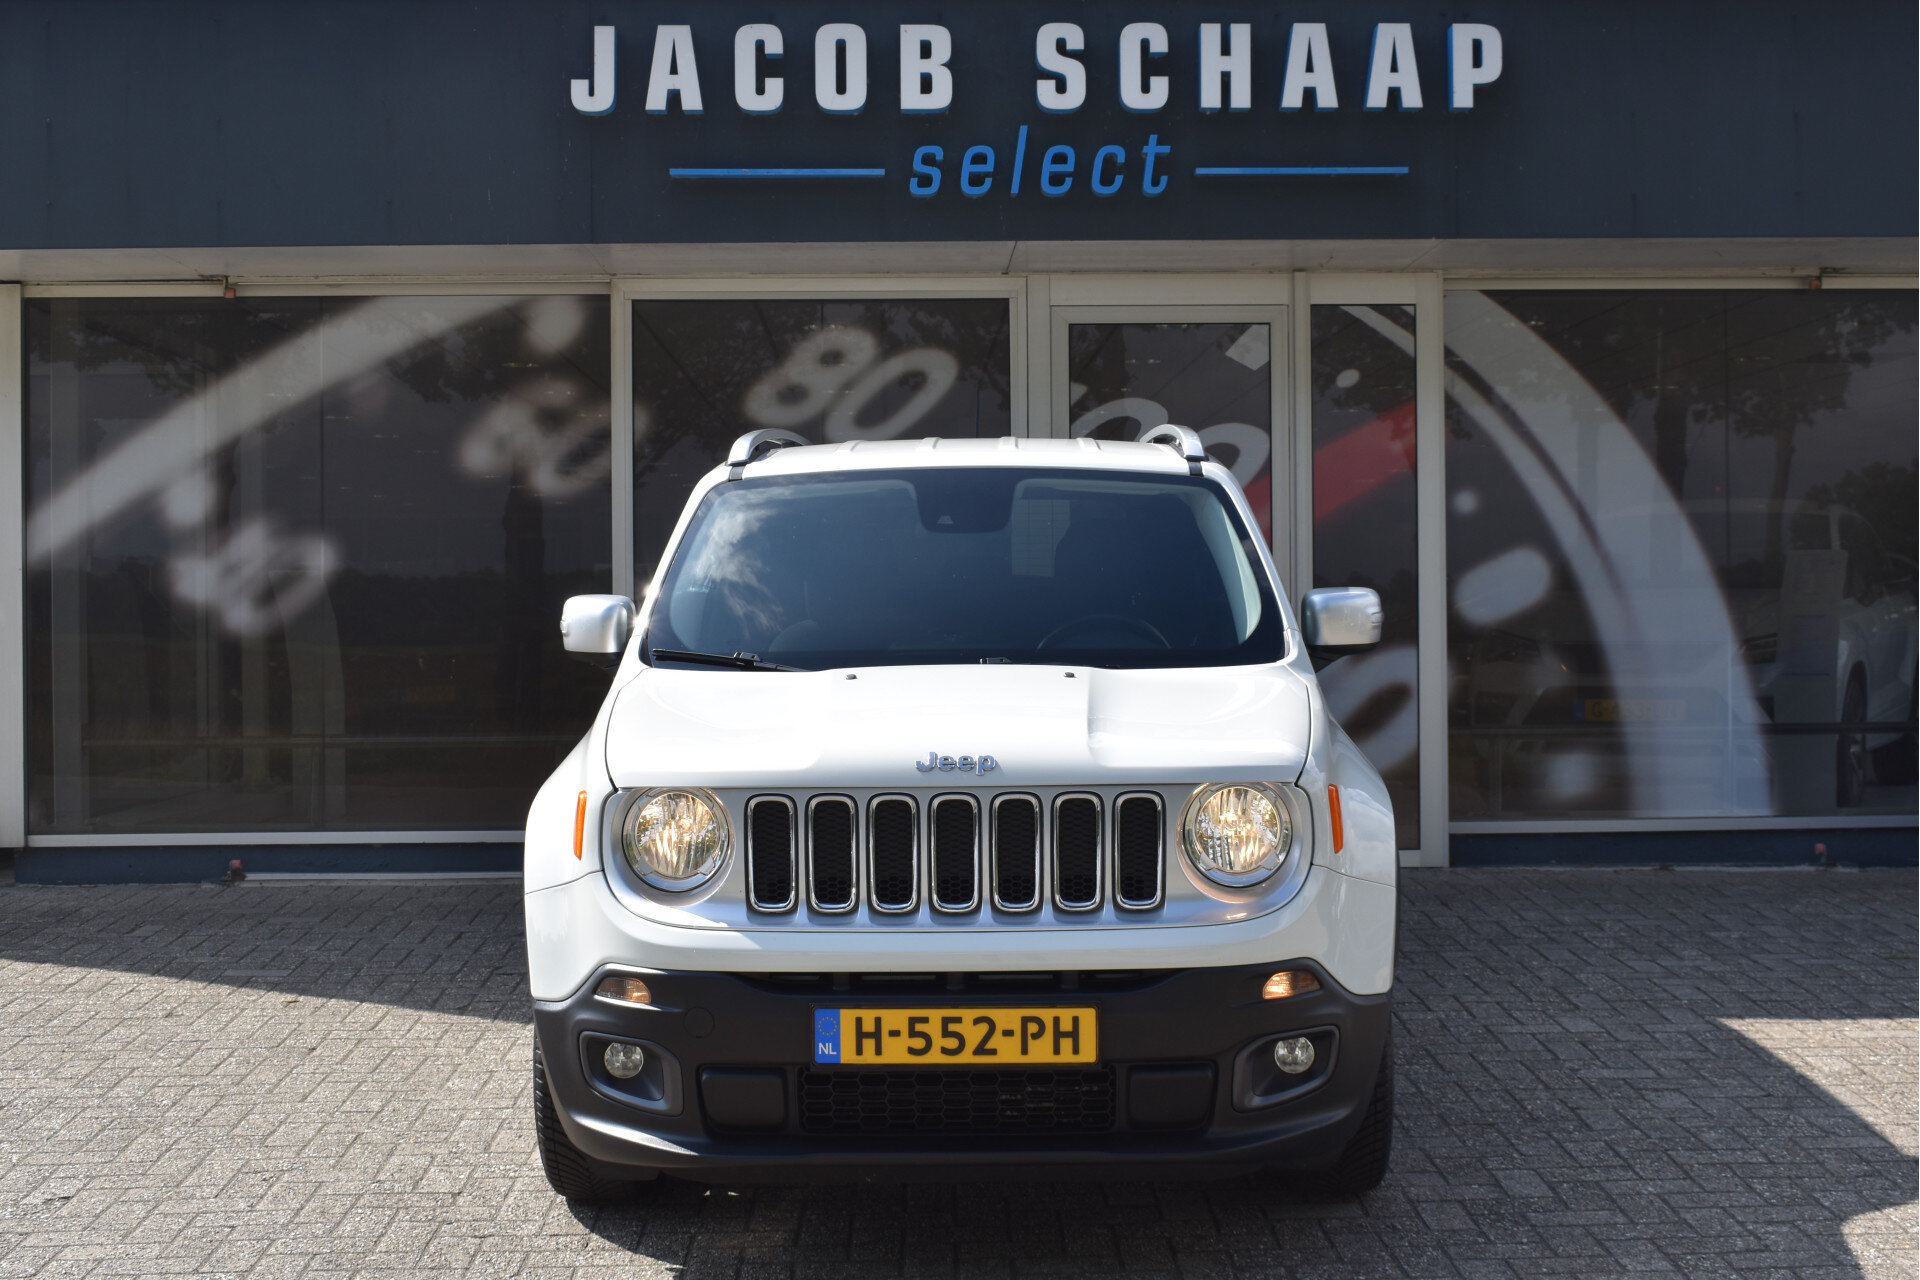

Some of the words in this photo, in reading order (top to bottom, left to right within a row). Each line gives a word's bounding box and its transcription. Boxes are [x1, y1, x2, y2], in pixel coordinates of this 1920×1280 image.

[570, 23, 953, 114] JACOB
[1035, 22, 1503, 113] SCHAAP
[909, 125, 1172, 197] select
[746, 327, 957, 440] 80
[915, 751, 996, 776] Jeep
[818, 1042, 837, 1055] NL
[855, 1016, 1080, 1056] H-552-PH
